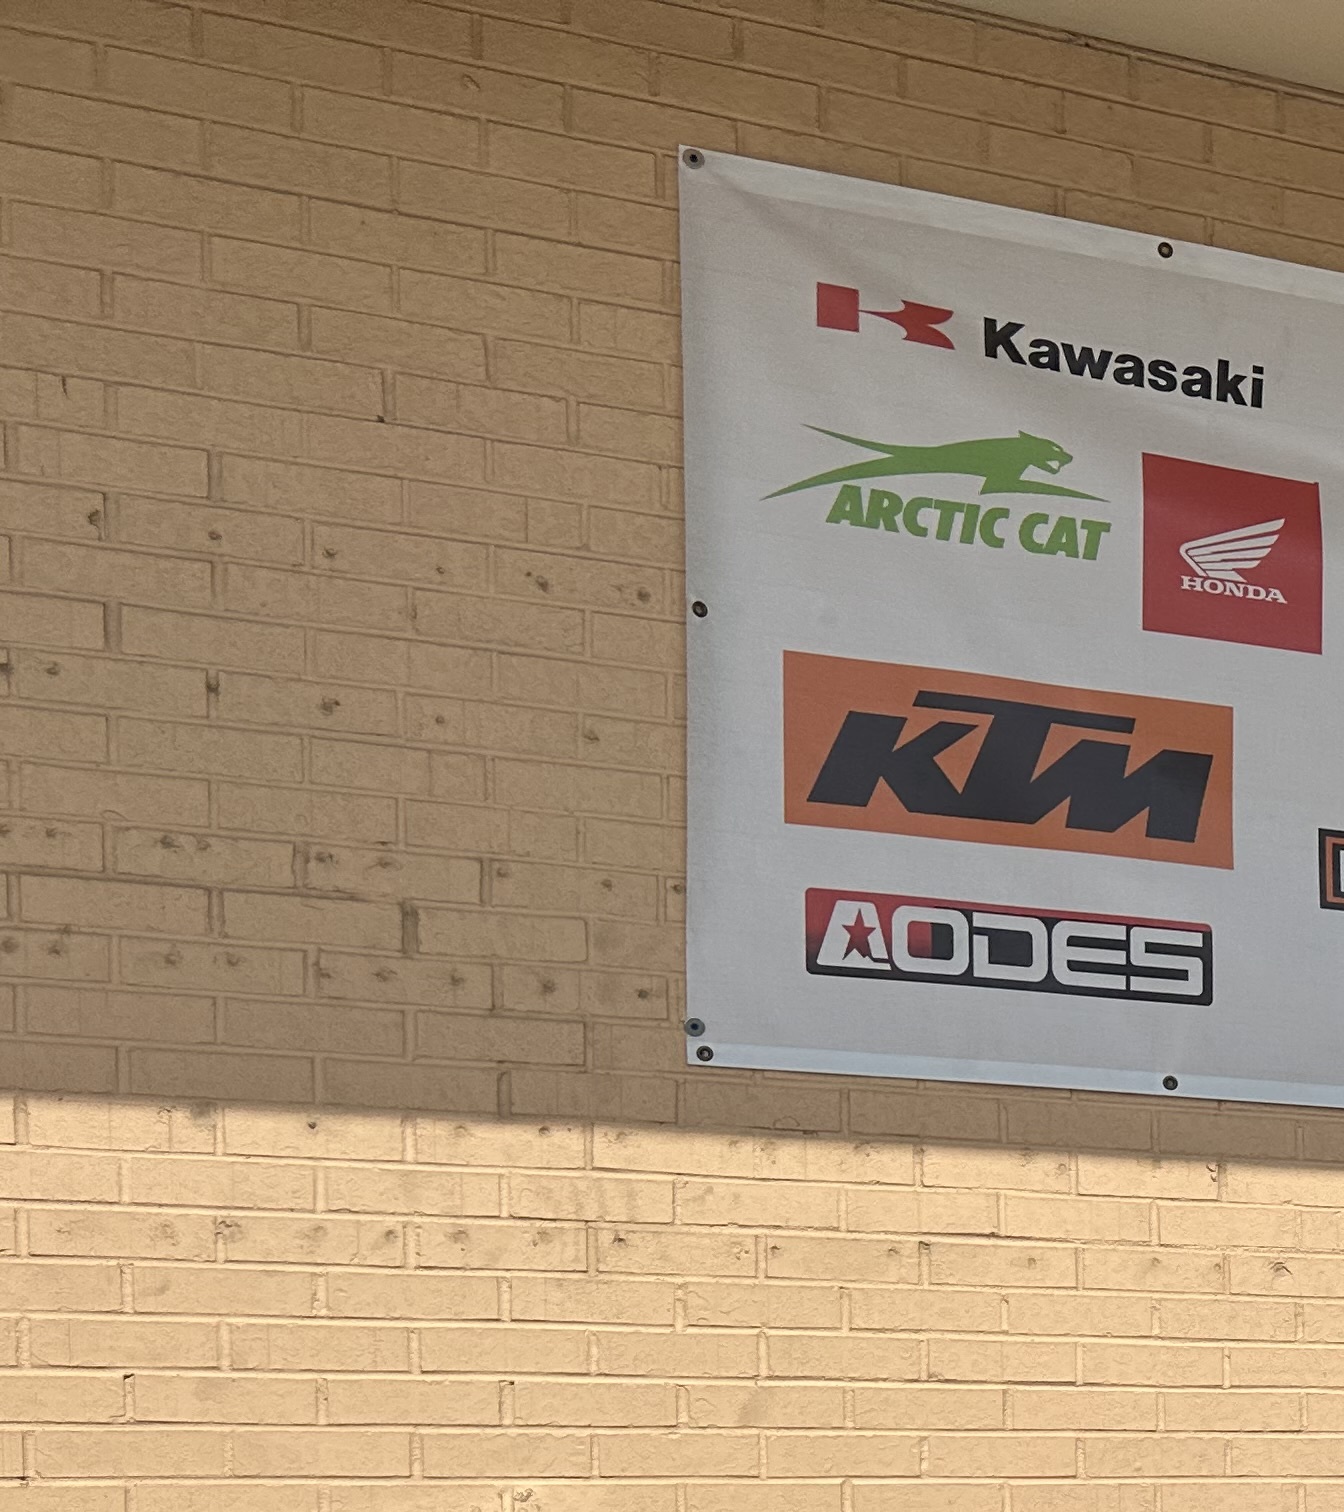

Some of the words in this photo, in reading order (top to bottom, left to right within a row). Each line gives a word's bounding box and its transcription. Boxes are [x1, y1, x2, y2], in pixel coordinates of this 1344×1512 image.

[983, 317, 1265, 409] Kawasaki
[825, 484, 1011, 548] ARCTIC
[1017, 512, 1112, 561] CAT
[1179, 575, 1289, 604] HONDA
[806, 690, 1213, 843] KTM
[816, 900, 1204, 998] AODES
